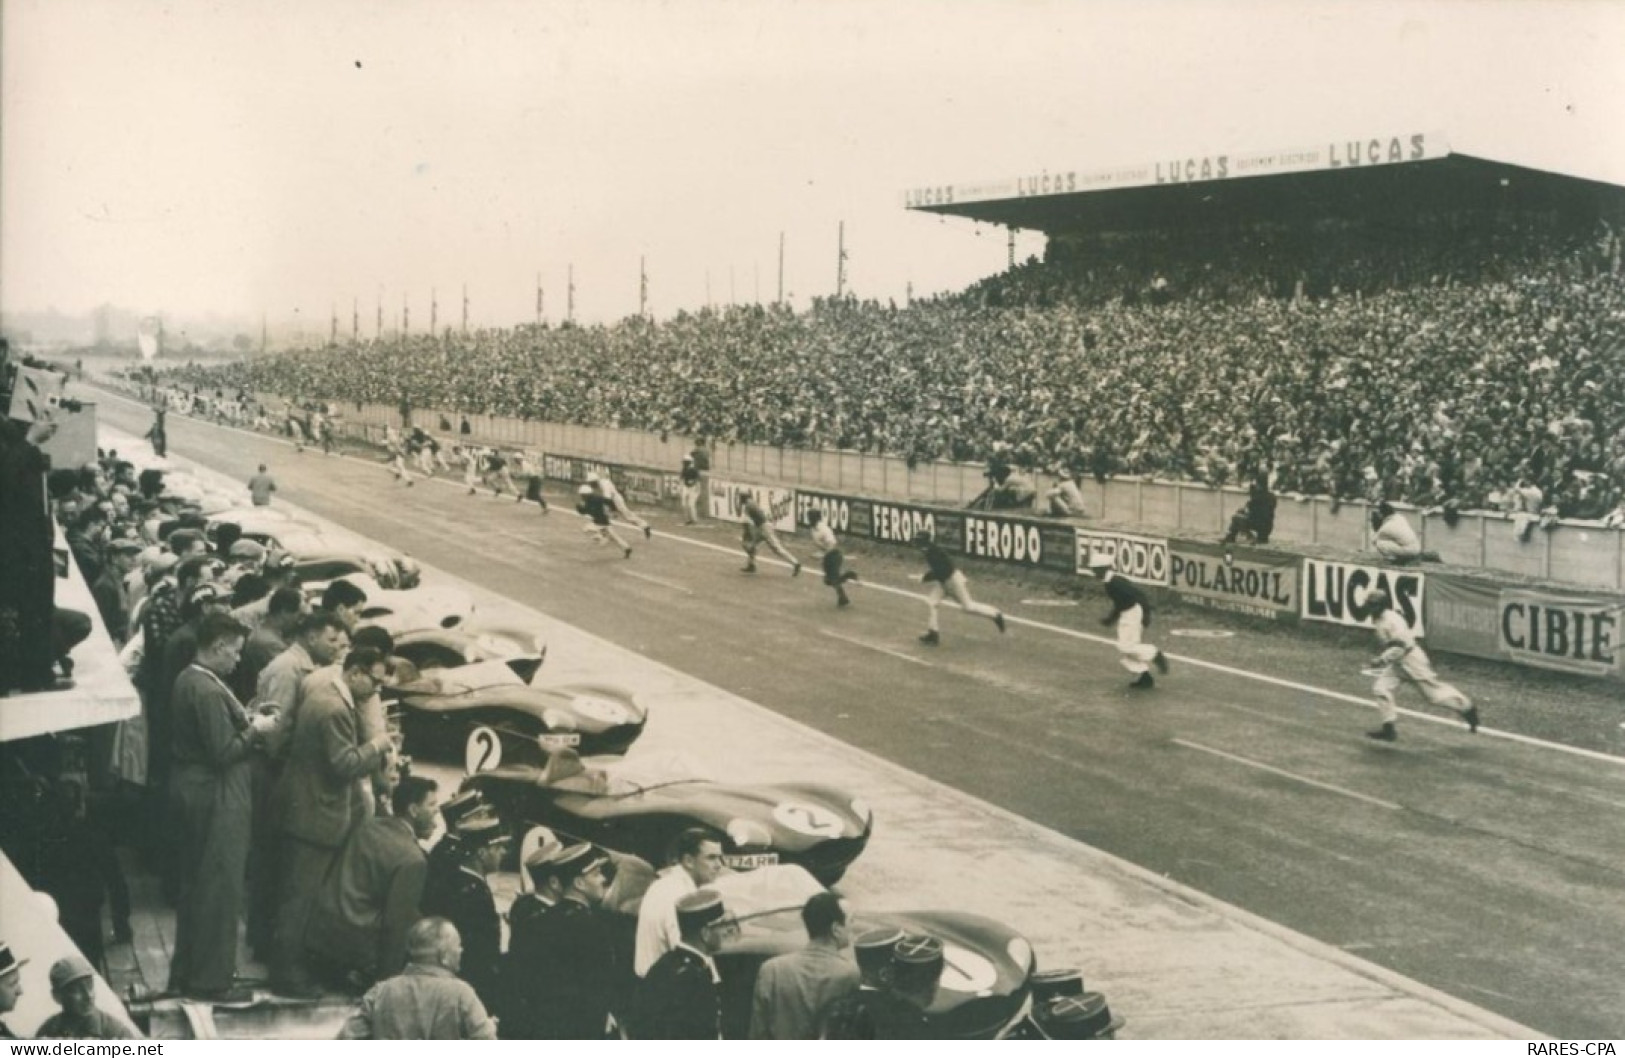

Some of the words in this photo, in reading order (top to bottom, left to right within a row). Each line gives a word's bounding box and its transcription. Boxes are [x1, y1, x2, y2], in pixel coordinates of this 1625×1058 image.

[1329, 133, 1425, 167] LUCAS
[1017, 171, 1076, 197] LUCAS
[1156, 155, 1229, 183] LUCAS
[904, 185, 954, 207] LUCAS
[964, 516, 1041, 564] FERODO
[1169, 553, 1290, 607] POLAROIL
[1307, 562, 1420, 631] LUCAS
[475, 730, 494, 772] 2
[787, 807, 832, 830] 2
